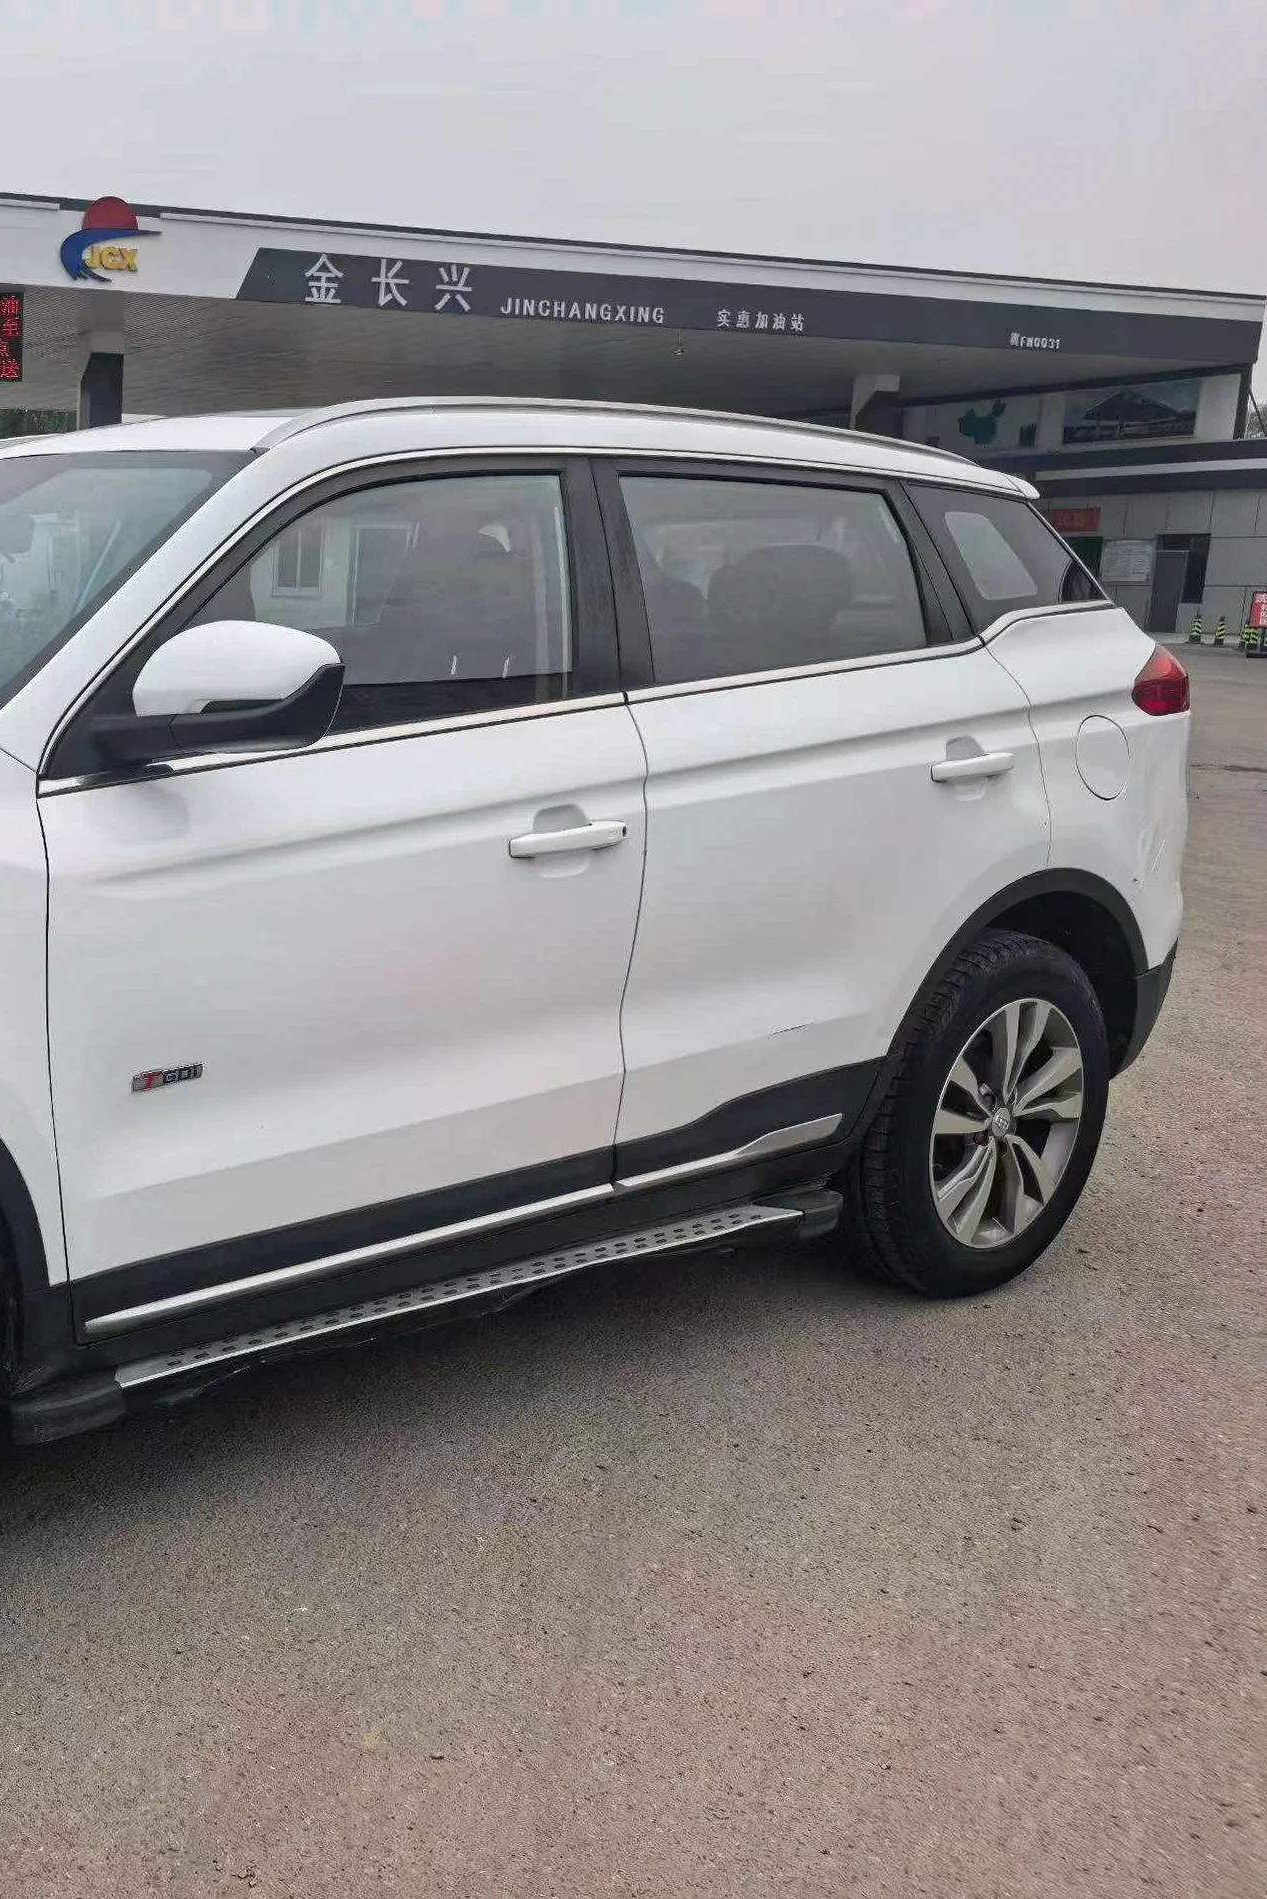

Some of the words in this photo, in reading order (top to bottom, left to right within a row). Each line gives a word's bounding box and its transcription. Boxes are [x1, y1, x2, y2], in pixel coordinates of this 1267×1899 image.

[304, 253, 473, 313] 金长兴
[499, 297, 665, 324] JINCHANGXING
[717, 308, 805, 332] 实惠加油站
